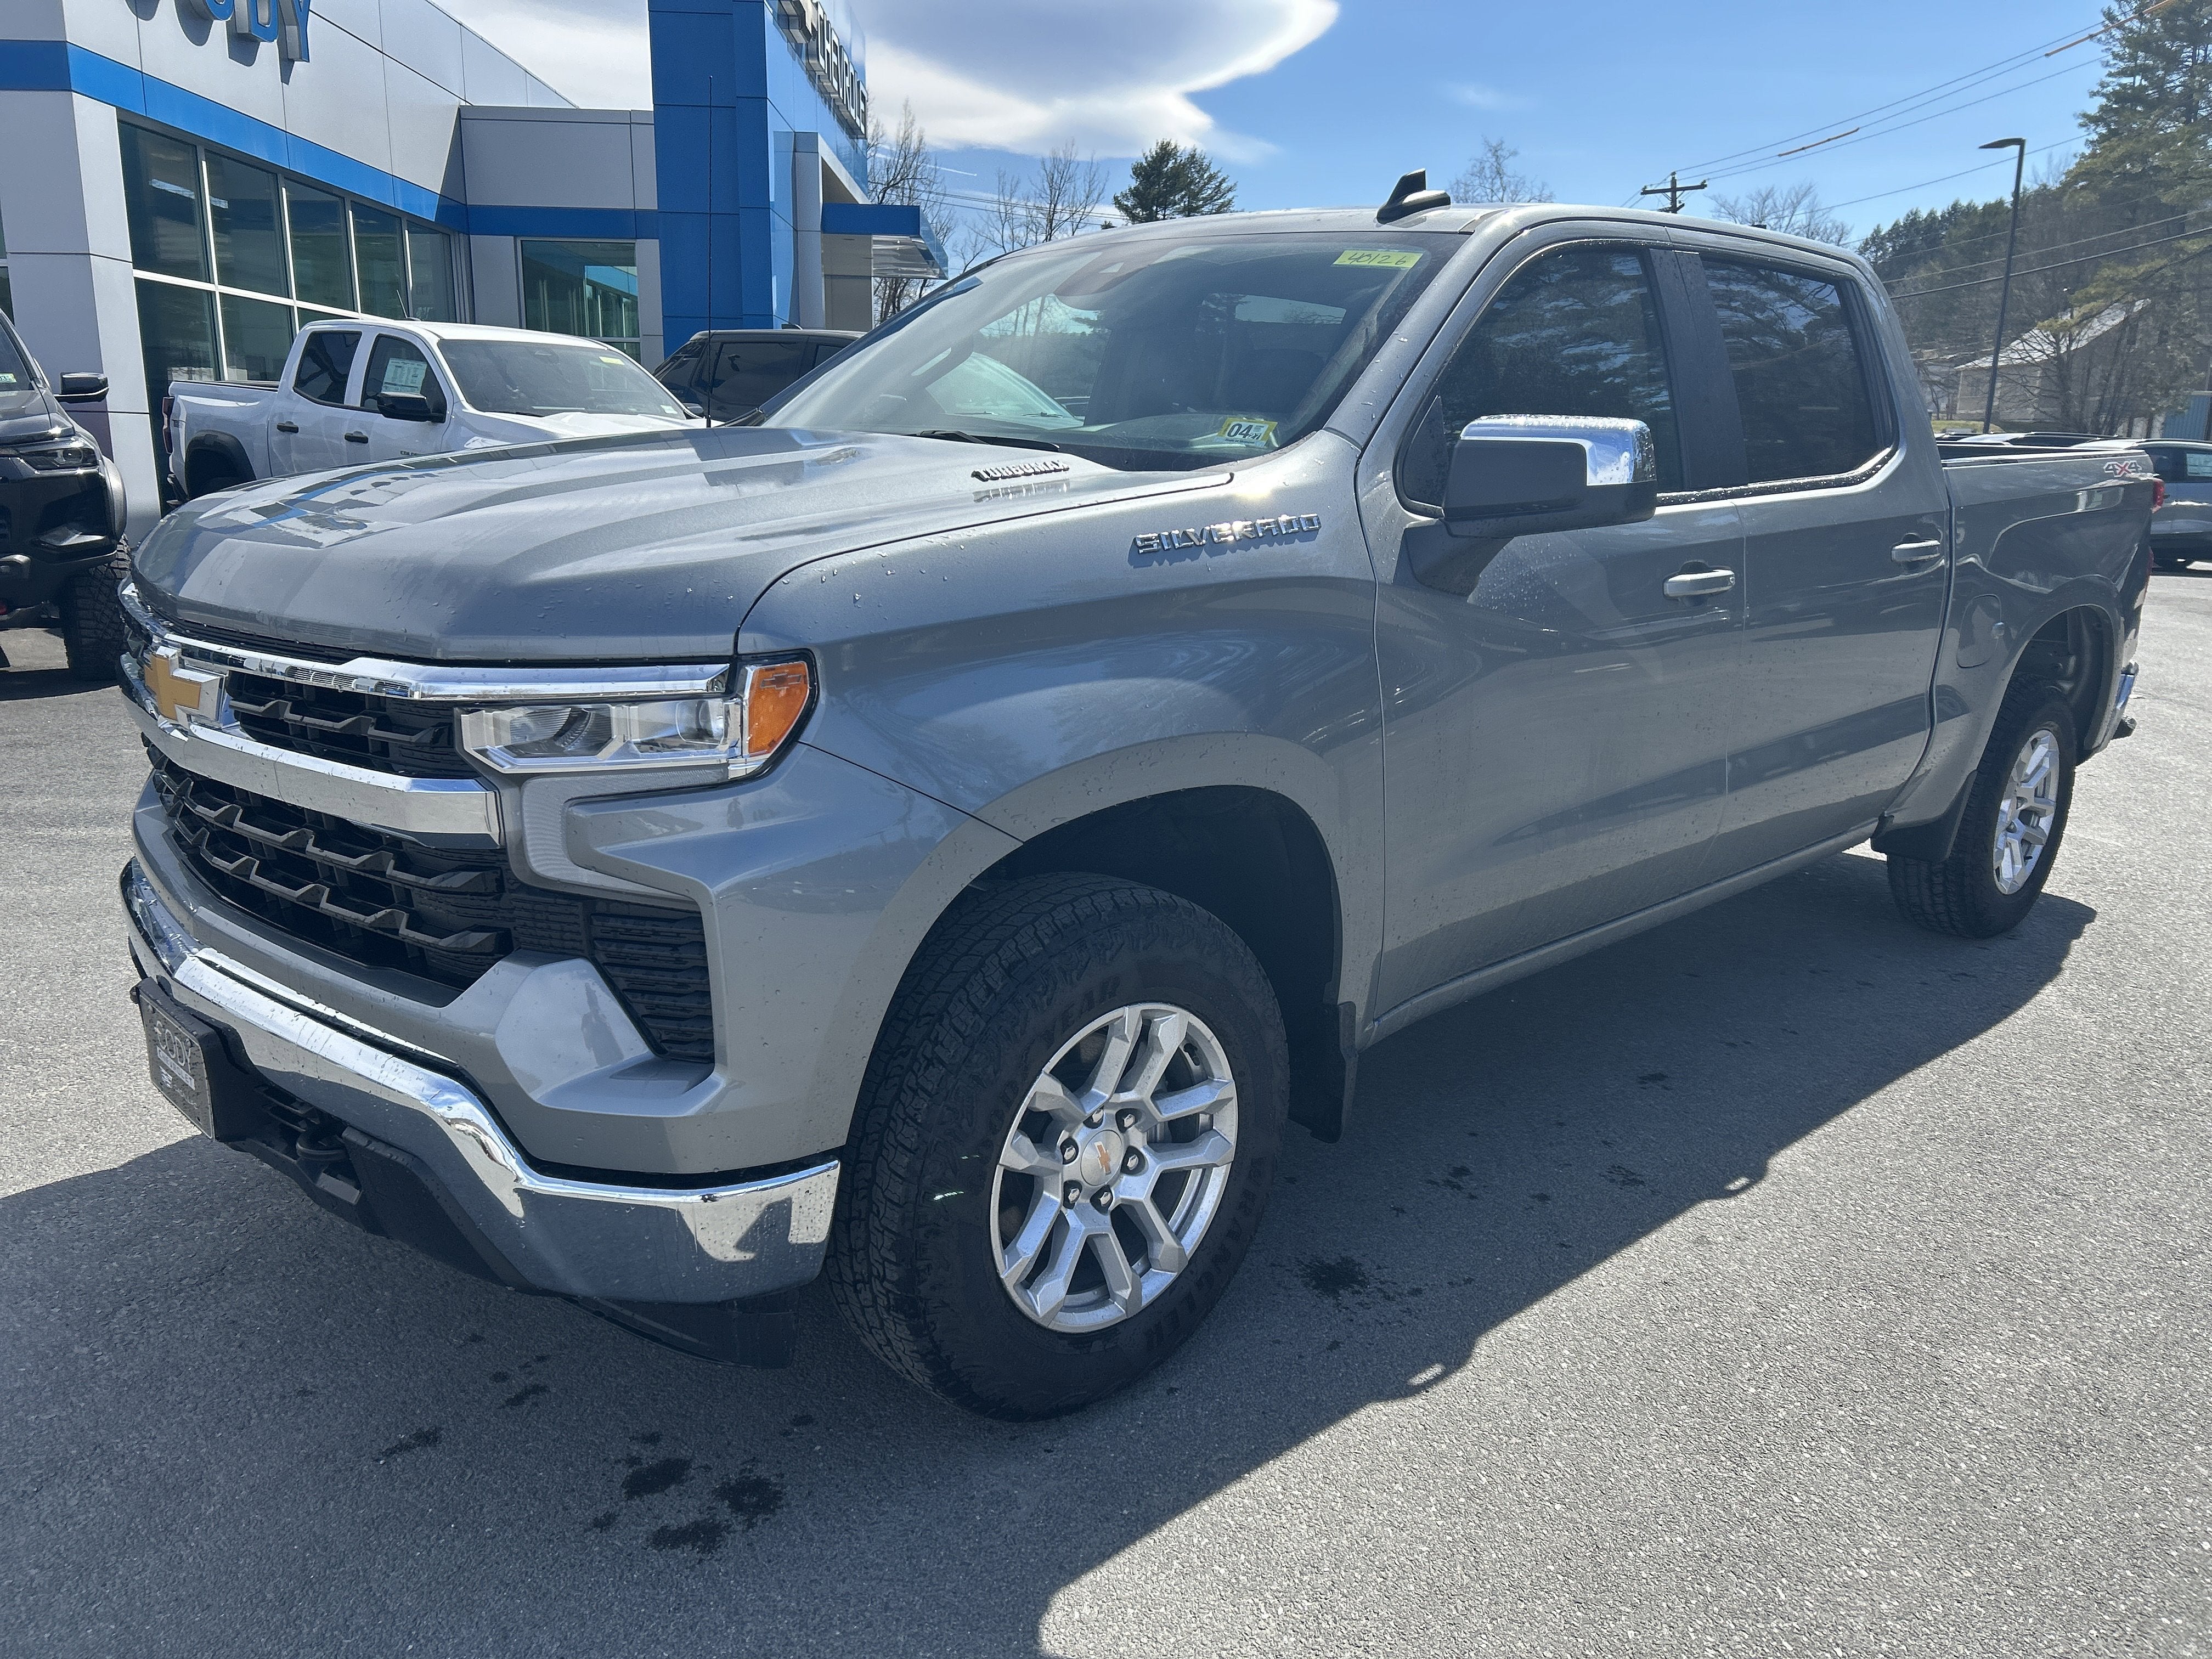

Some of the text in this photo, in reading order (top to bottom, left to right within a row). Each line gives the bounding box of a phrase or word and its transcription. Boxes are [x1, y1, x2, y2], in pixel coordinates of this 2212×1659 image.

[1227, 423, 1254, 438] 04
[972, 460, 1070, 482] TURBOMAX
[1134, 513, 1322, 554] SILVERADO
